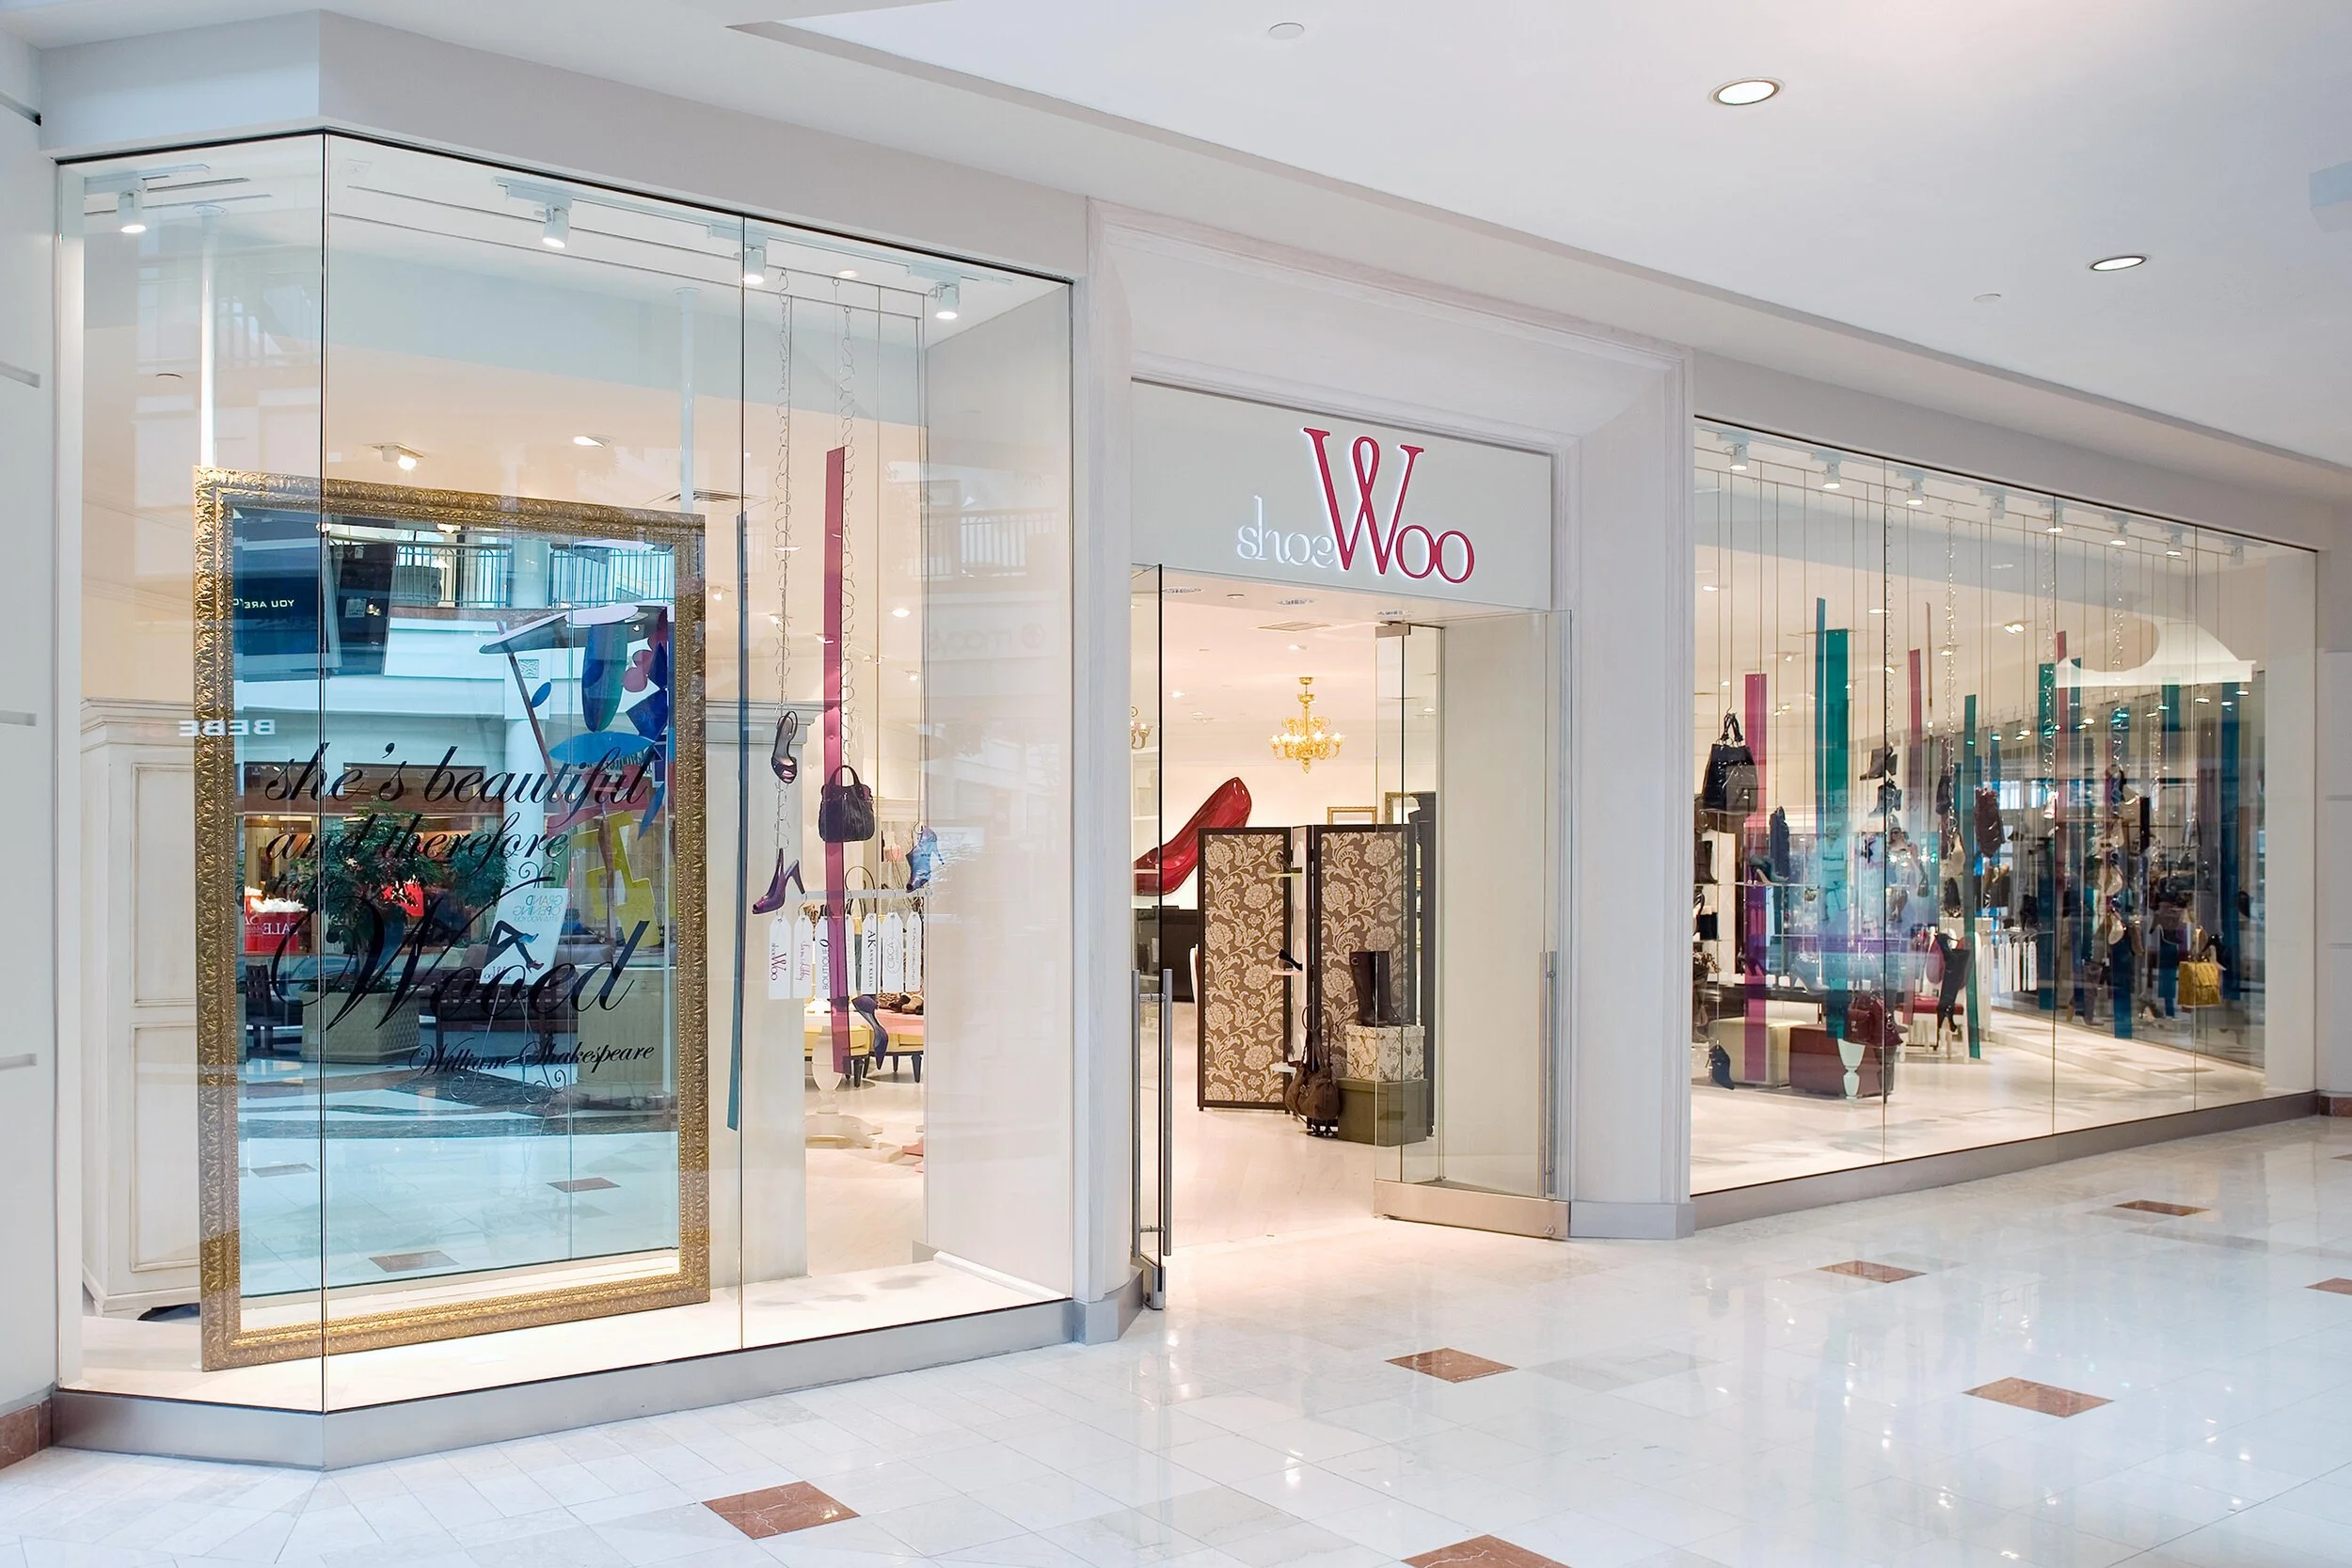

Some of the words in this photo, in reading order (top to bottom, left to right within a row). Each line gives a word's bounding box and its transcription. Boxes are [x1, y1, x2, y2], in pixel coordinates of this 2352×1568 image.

[1236, 495, 1336, 569] shoe
[1301, 427, 1476, 583] Woo
[265, 742, 408, 801] she's
[423, 745, 655, 828] beautiful
[266, 814, 377, 860] and
[381, 811, 568, 877] therefore
[267, 876, 650, 1033] Wooed
[771, 952, 787, 981] Woo
[867, 929, 877, 948] AK
[408, 1037, 510, 1076] William
[519, 1032, 655, 1073] Shakespeare
